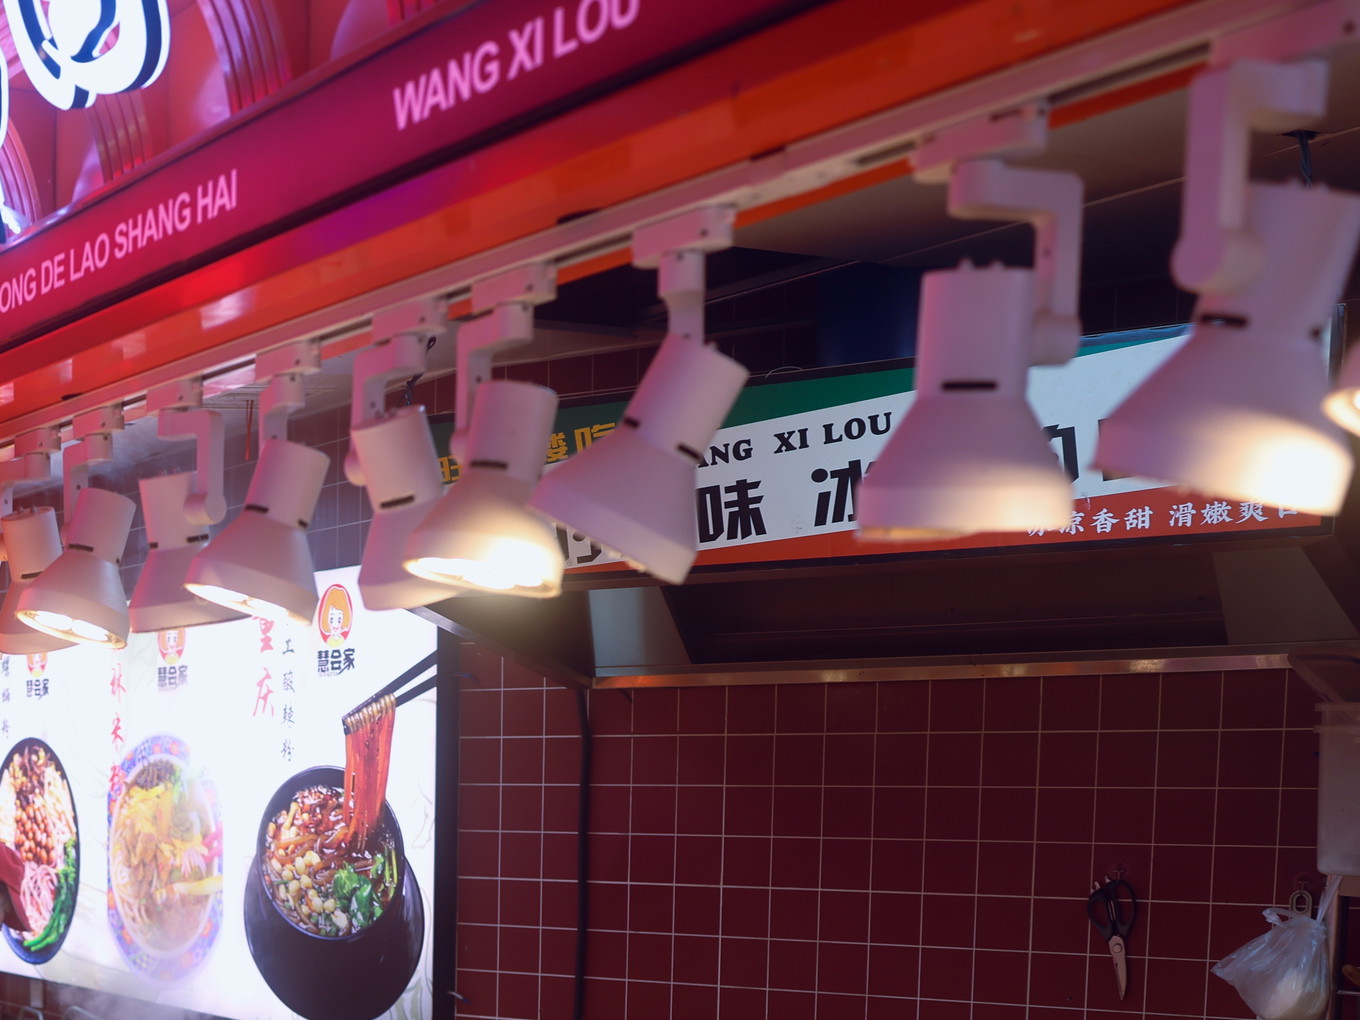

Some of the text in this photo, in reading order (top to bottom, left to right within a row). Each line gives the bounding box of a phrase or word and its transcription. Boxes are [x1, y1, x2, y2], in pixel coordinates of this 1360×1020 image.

[393, 0, 641, 131] WANG XI LOU
[40, 252, 66, 295] DE
[69, 232, 111, 282] LAO
[114, 192, 192, 260] SHANG
[196, 168, 238, 225] HAI
[773, 428, 810, 454] XI
[822, 411, 892, 445] LOU
[1026, 505, 1154, 537] 凉香甜
